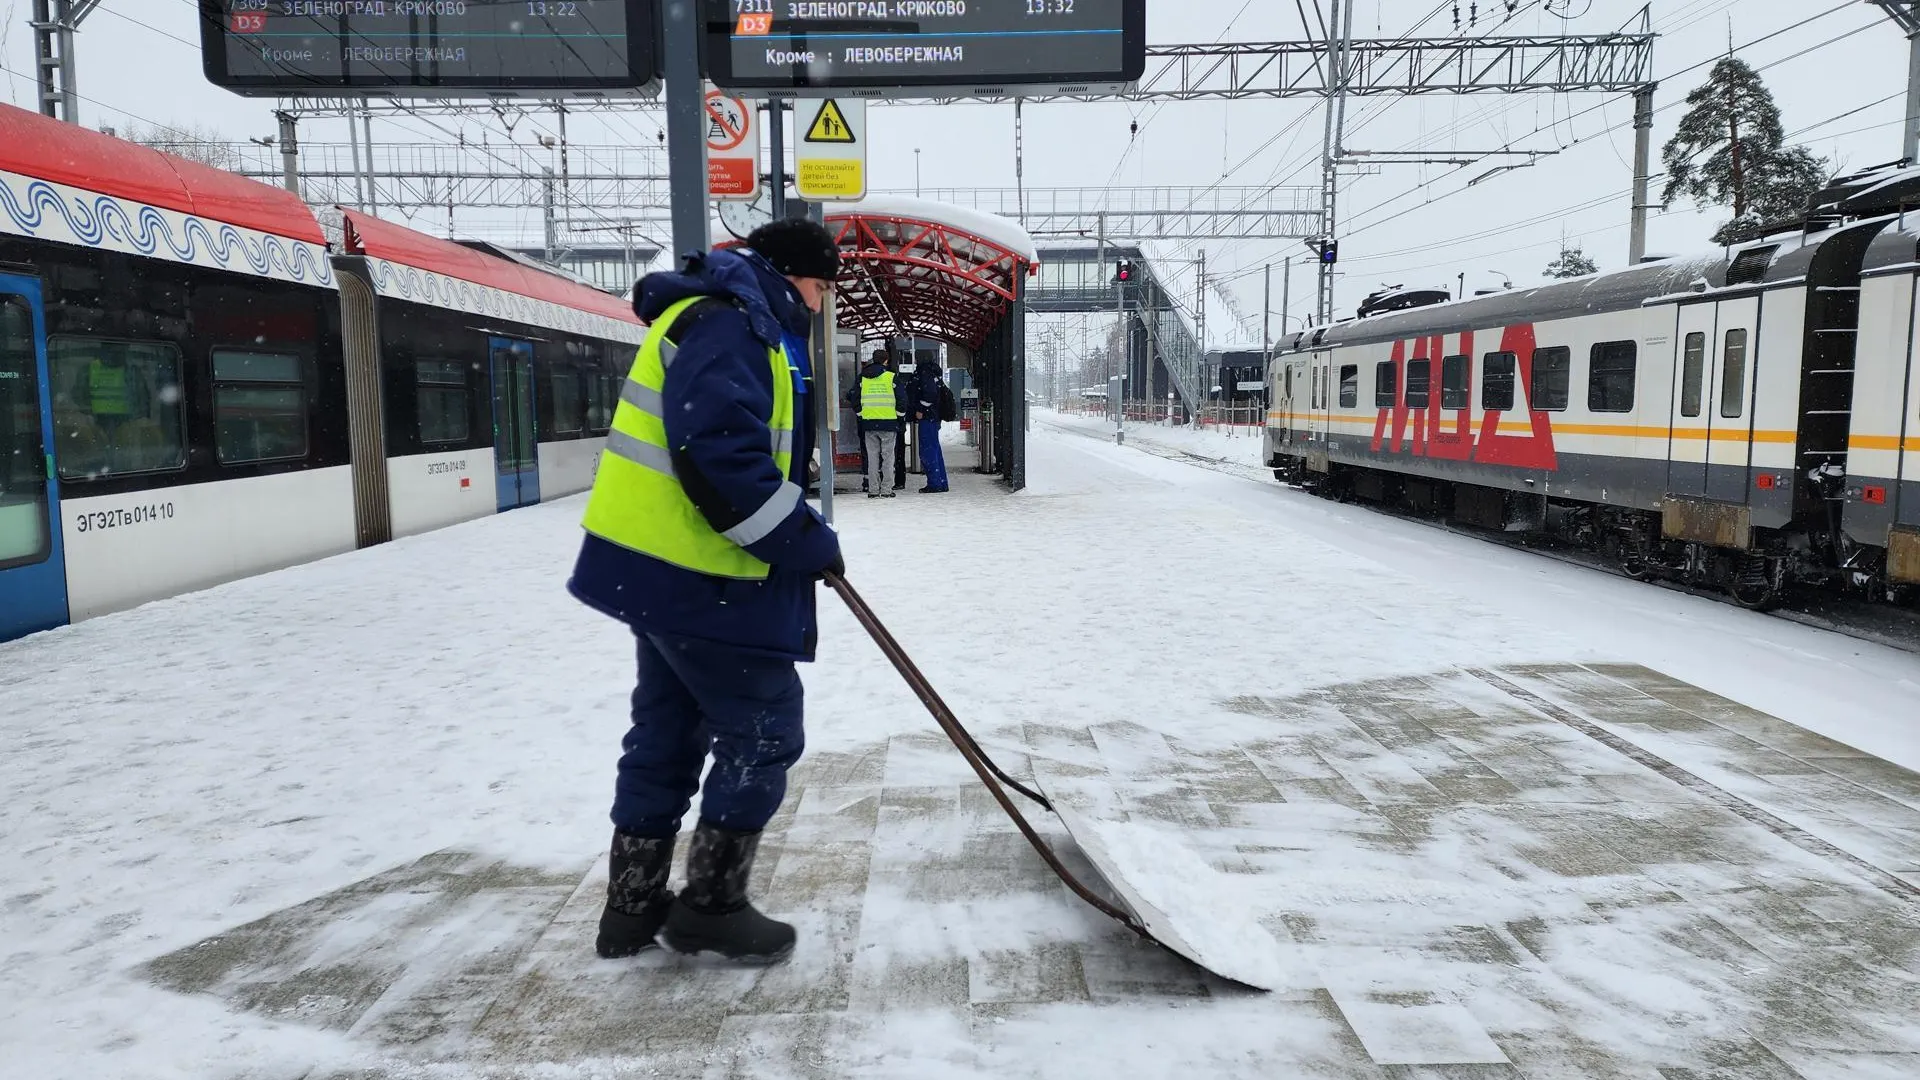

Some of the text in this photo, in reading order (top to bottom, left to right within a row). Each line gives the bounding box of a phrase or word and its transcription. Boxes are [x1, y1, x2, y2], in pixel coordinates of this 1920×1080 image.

[284, 1, 465, 16] ЗЕЛЕНОГРАД-КРЮКОВО
[528, 2, 576, 16] 13:22
[735, 0, 1074, 18] 7311 ЗЕЛЕНОГРАД-КРЮКОВО 13:32
[237, 16, 261, 29] D3
[743, 18, 766, 32] D3
[262, 48, 312, 64] Кроме
[343, 47, 465, 61] ЛЕВОБЕРЕЖНАЯ
[766, 48, 815, 65] Кроме
[844, 46, 962, 62] ЛЕВОБЕРЕЖНАЯ
[802, 163, 855, 171] Не оставляйте
[803, 182, 846, 191] присмотра!
[1371, 322, 1559, 471] МЦД
[77, 502, 174, 532] ЭГЭ2Тв 014 10
